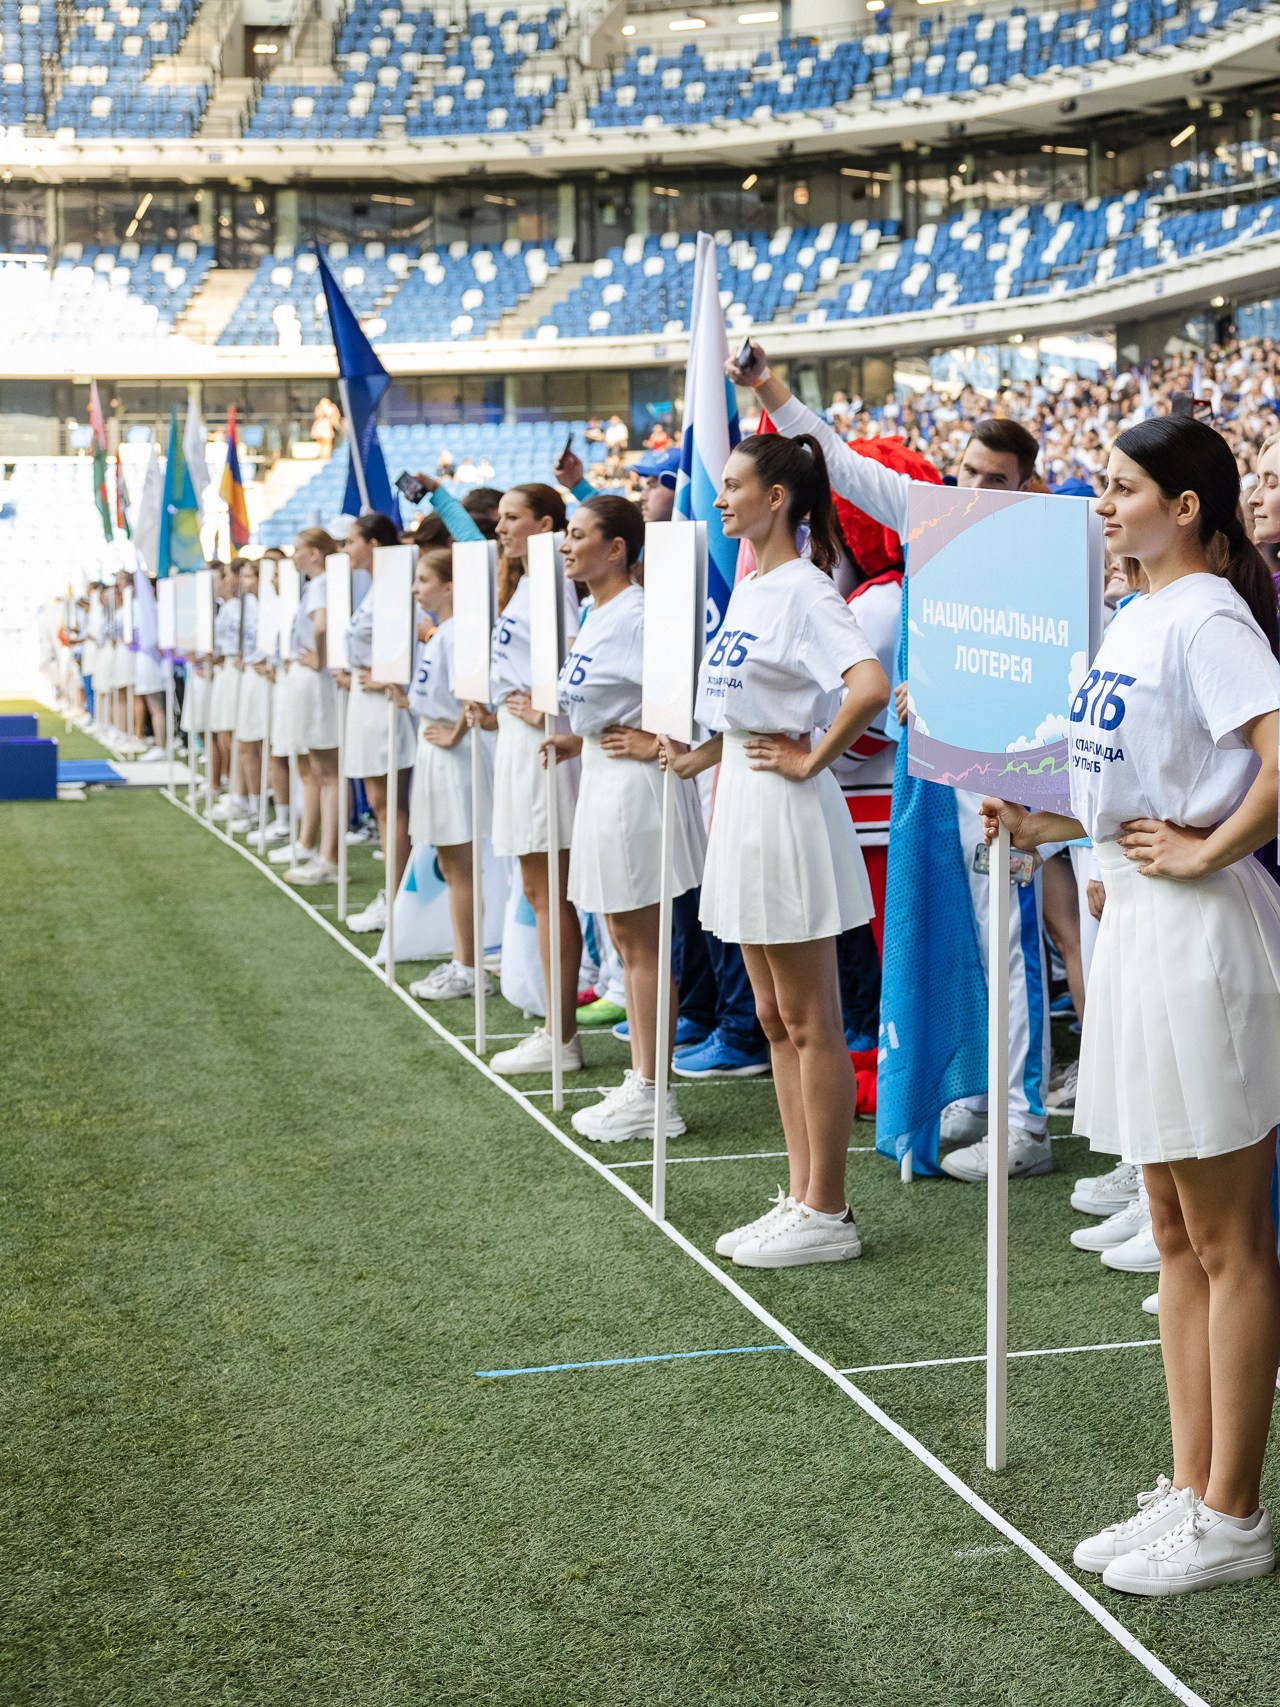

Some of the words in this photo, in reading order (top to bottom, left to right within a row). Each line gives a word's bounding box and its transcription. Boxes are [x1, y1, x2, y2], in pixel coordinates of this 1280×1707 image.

[922, 598, 1069, 648] НАЦИОНАЛЬНАЯ
[954, 644, 1032, 684] ЛОТЕРЕЯ
[1070, 669, 1137, 731] ВТБ
